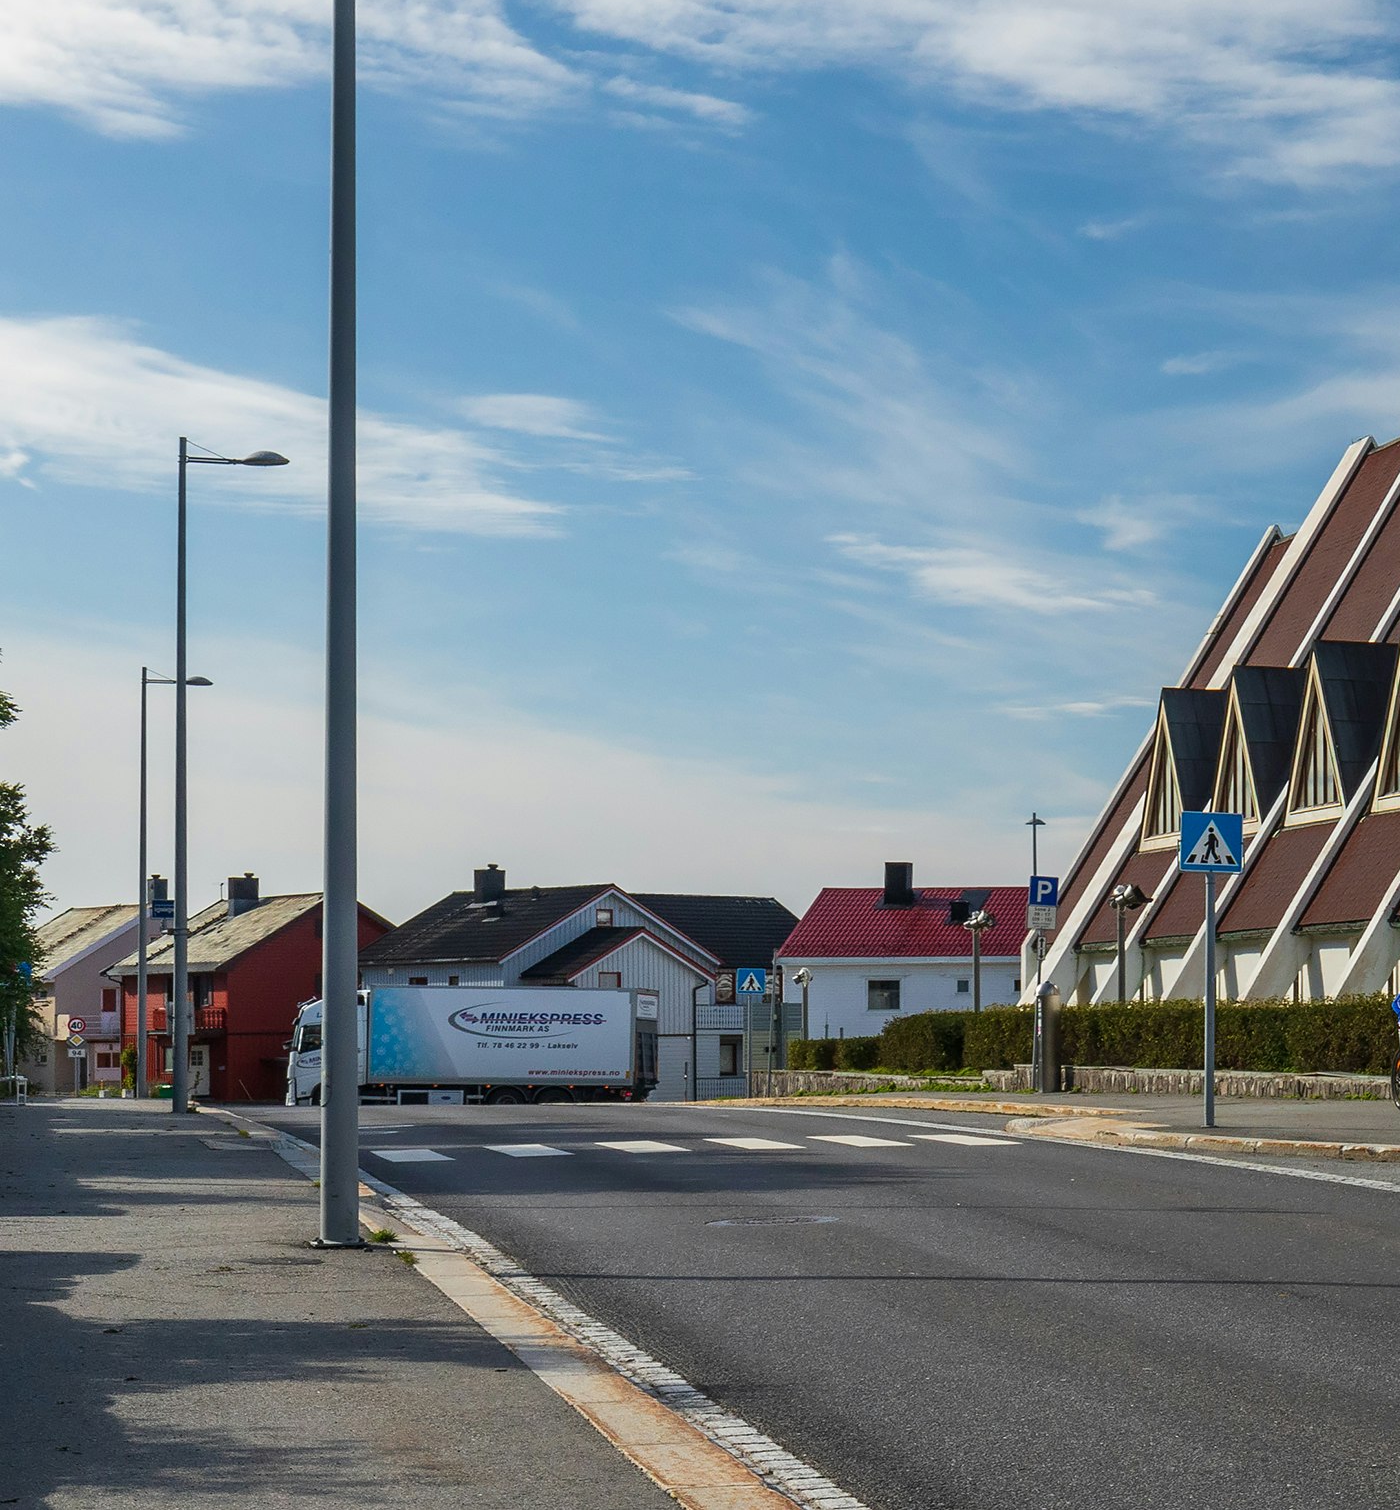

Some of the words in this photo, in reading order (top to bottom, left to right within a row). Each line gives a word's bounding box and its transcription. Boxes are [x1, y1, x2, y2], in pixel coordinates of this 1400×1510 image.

[1036, 880, 1053, 903] P
[480, 1012, 604, 1025] MINIEKSPRESS
[70, 1021, 83, 1030] 40
[528, 1069, 621, 1077] www.miniekspress.no
